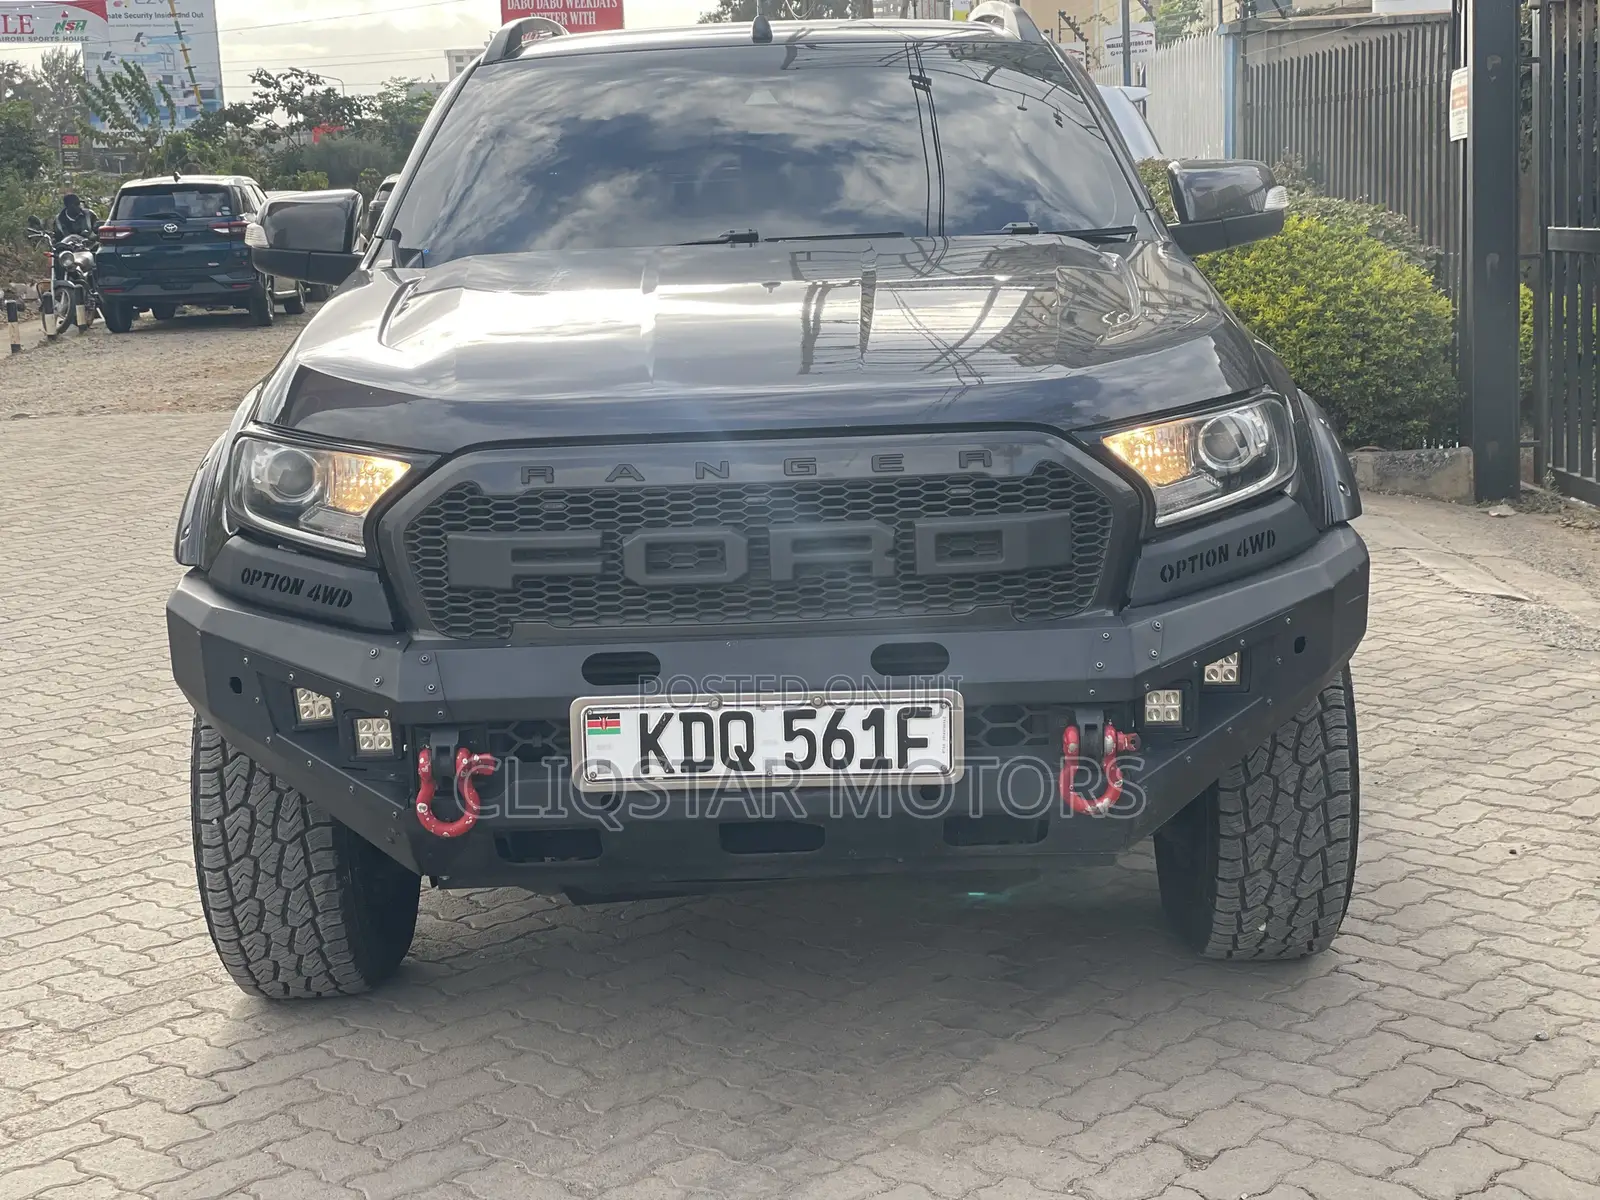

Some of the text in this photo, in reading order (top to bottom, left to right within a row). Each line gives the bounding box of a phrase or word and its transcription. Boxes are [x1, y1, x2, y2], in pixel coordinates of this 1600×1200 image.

[123, 12, 153, 20] Security
[507, 0, 618, 10] DABO DABO WEEKDAYS
[569, 11, 597, 25] WITH
[520, 449, 993, 484] RANGER
[446, 511, 1071, 589] FORD
[1160, 529, 1276, 583] OPTION 4WD
[240, 567, 353, 608] OPTION 4WD
[639, 711, 756, 774] KDQ
[783, 706, 933, 770] 561F
